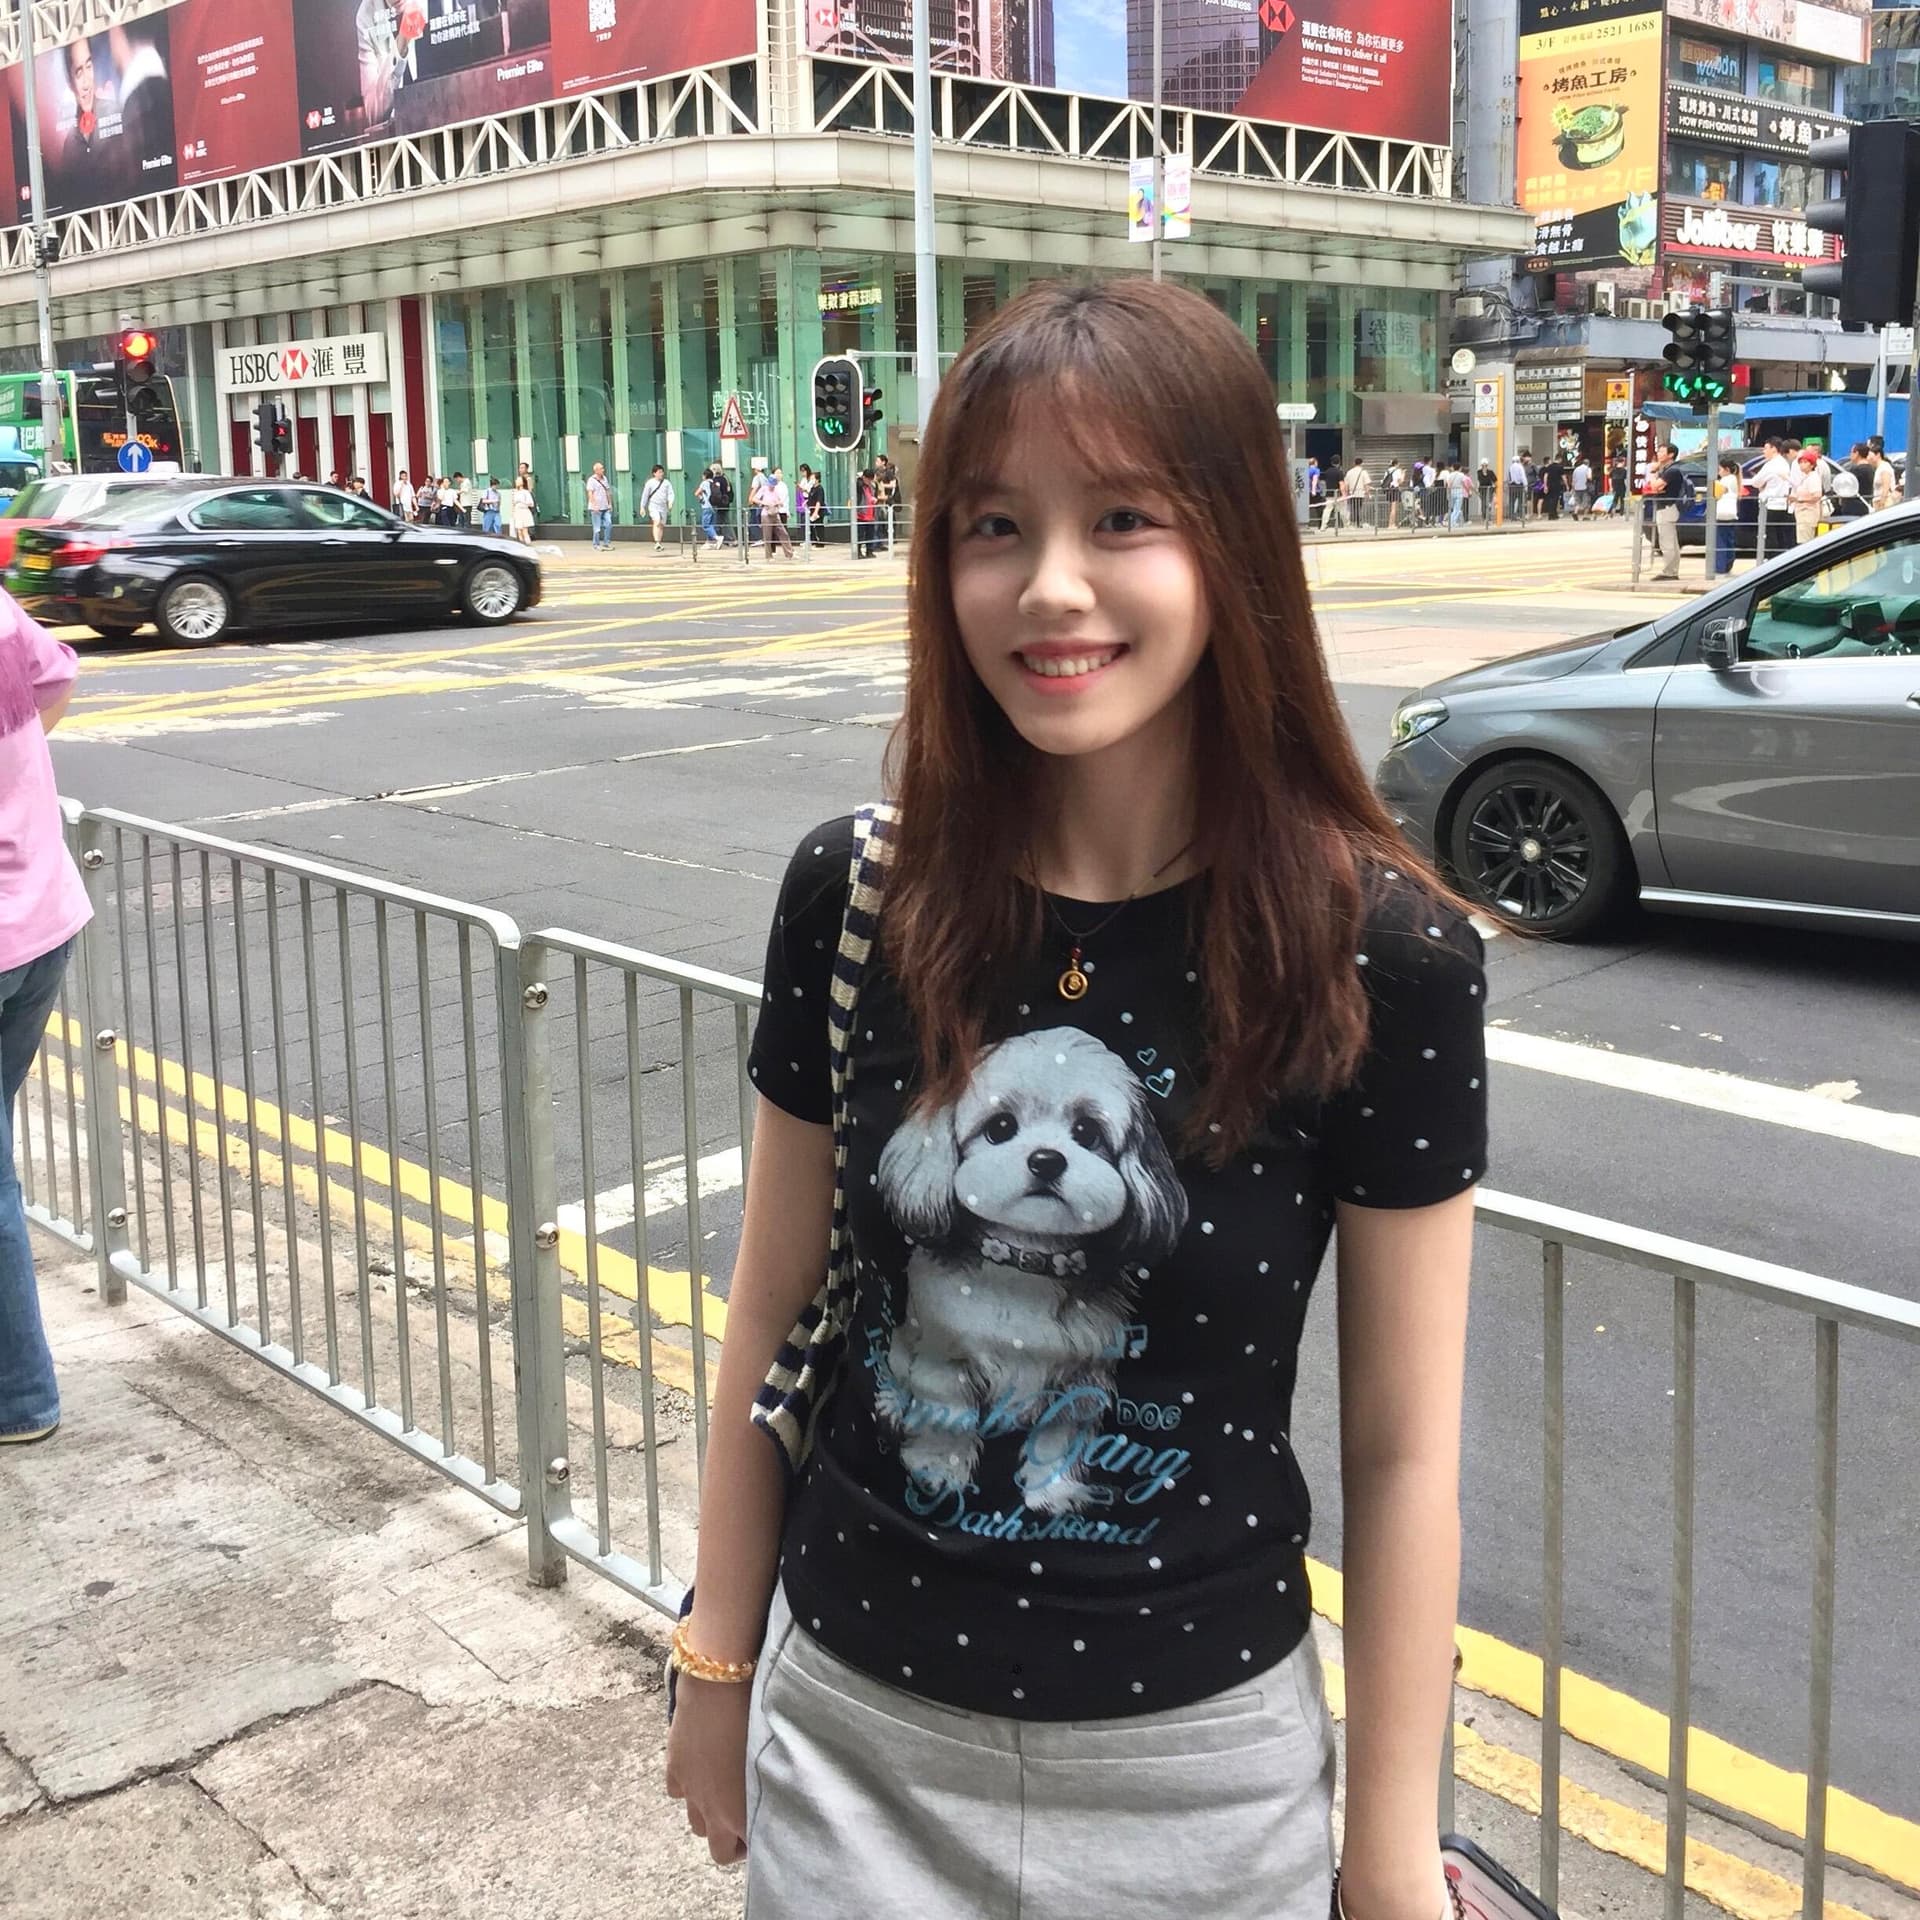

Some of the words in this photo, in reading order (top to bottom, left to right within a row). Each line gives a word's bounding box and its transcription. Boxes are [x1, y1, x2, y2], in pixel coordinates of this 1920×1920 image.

[865, 25, 890, 38] Opening
[1597, 25, 1622, 39] 2521
[1628, 19, 1655, 33] 1688
[1536, 37, 1555, 50] 3/F
[497, 64, 527, 81] Premier
[1552, 67, 1628, 94] 烤魚工房
[1678, 116, 1696, 128] HOW
[1700, 120, 1715, 131] FISH
[1716, 123, 1737, 134] GONG
[1738, 126, 1758, 137] FANG
[1676, 206, 1760, 250] Jollibee
[229, 351, 280, 385] HSBC
[312, 343, 367, 378] 滙豐
[1116, 1398, 1182, 1431] DOG
[1014, 1384, 1193, 1504] Gang
